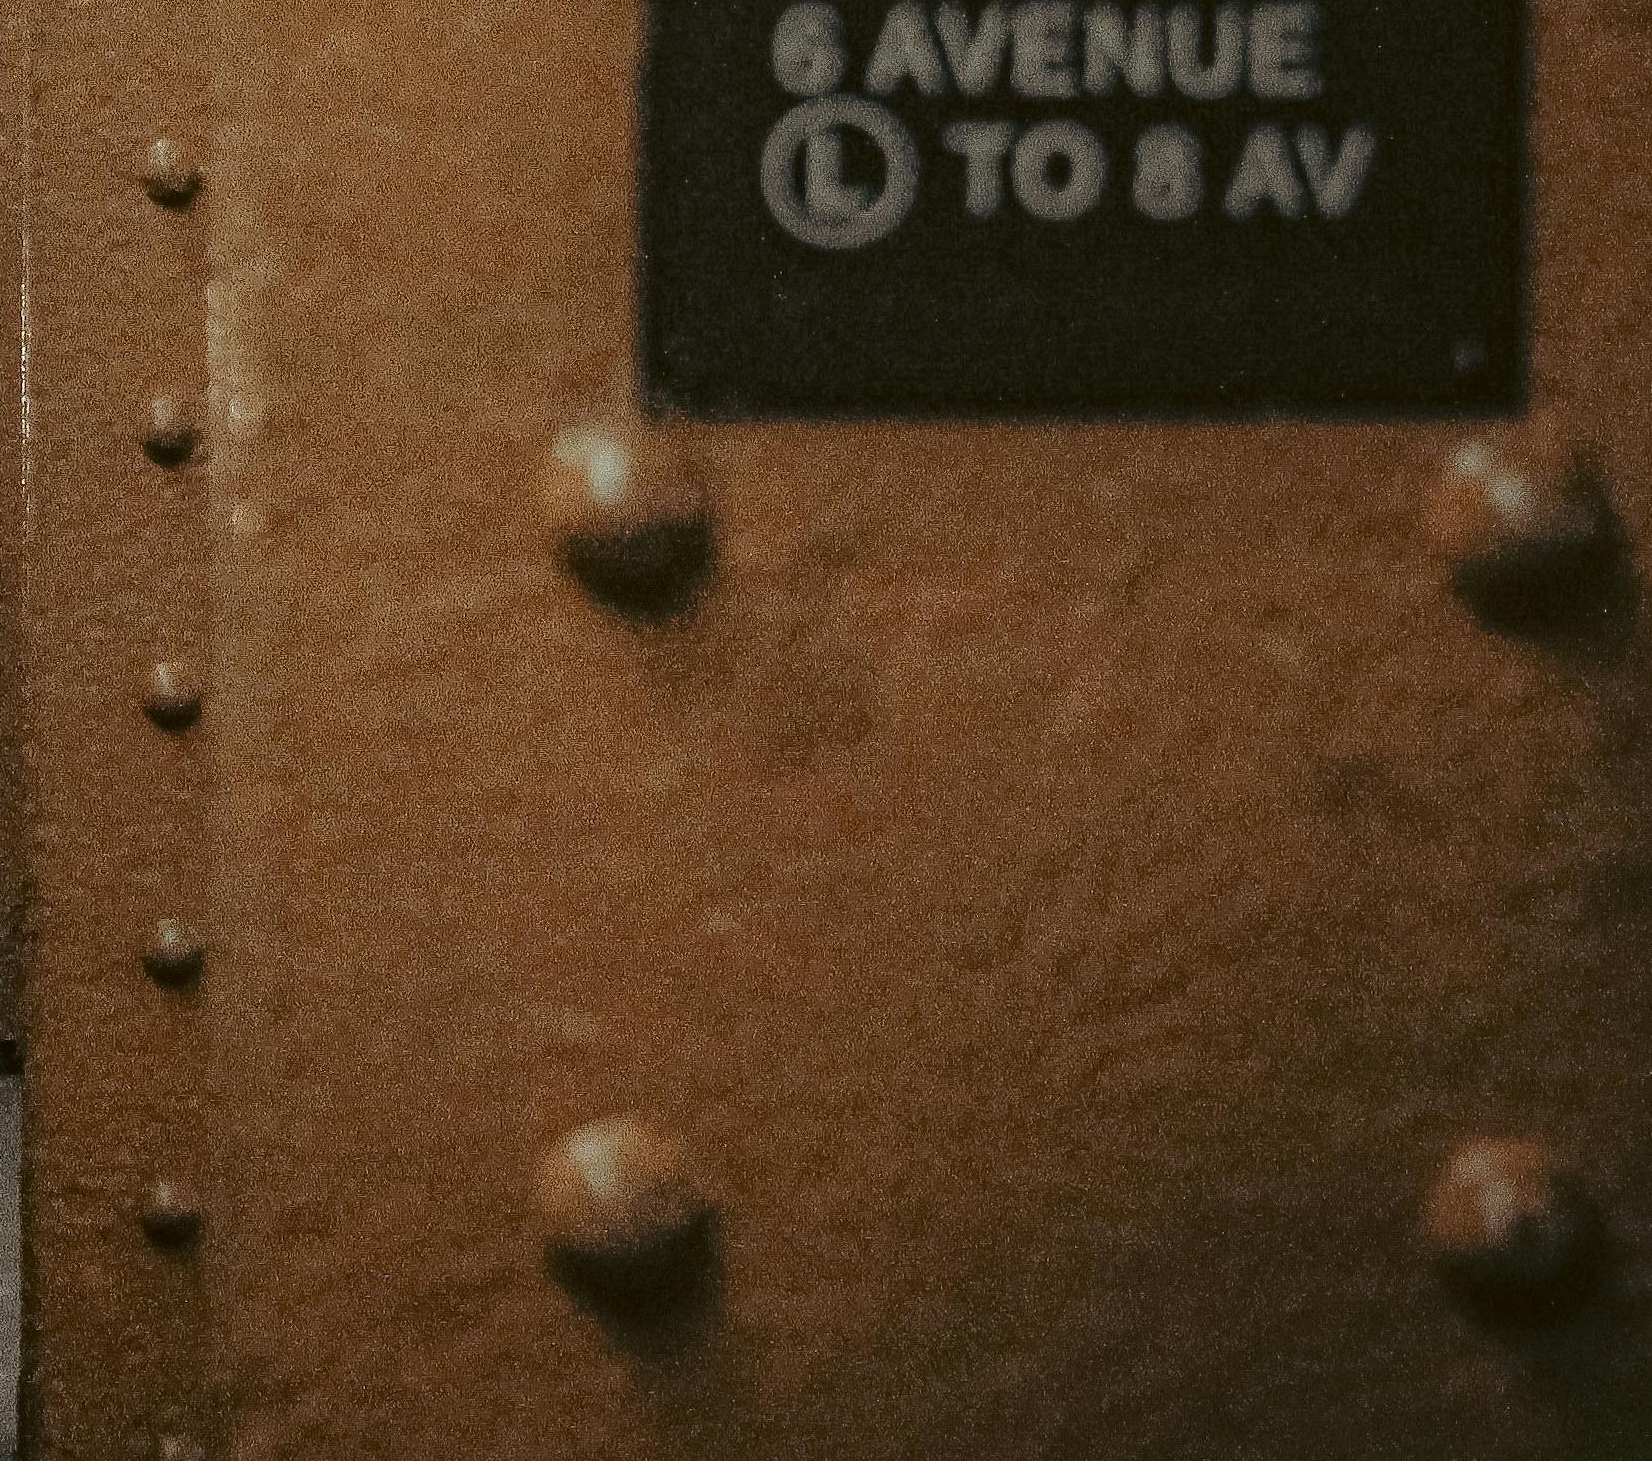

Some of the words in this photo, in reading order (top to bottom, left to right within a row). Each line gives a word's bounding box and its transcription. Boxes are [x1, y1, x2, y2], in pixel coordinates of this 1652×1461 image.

[769, 0, 847, 96] 6
[943, 120, 1108, 223] TO
[1131, 121, 1203, 222] 8
[1223, 122, 1379, 221] AV
